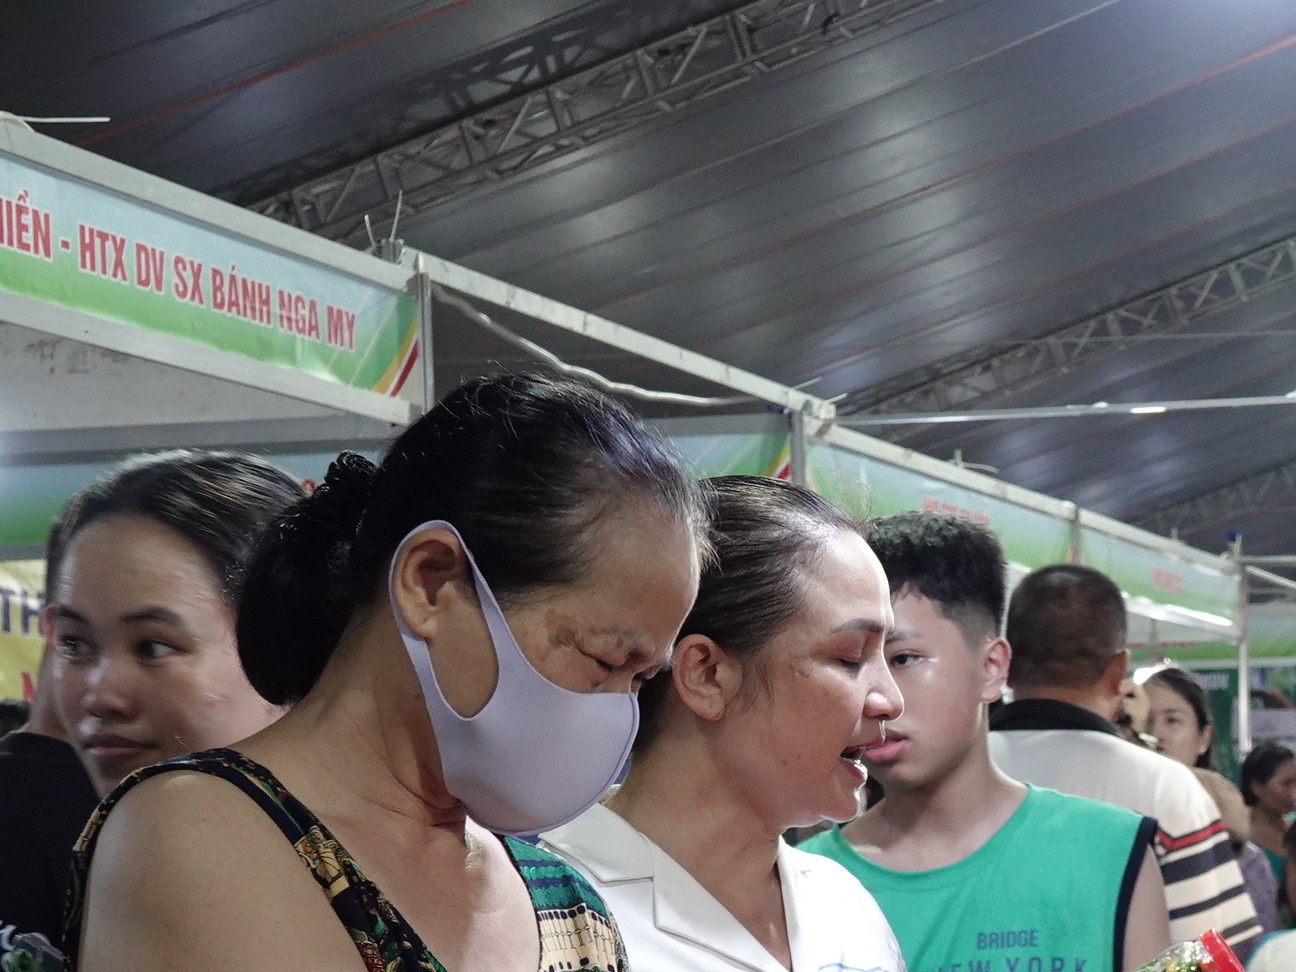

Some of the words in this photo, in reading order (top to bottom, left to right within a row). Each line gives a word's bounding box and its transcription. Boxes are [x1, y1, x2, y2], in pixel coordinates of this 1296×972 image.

[78, 223, 128, 283] HTX
[134, 241, 165, 293] DV
[173, 254, 205, 306] SX
[210, 264, 272, 326] BÁNH
[277, 288, 321, 341] NGA
[325, 304, 356, 351] MY
[976, 929, 1039, 951] BRIDGE
